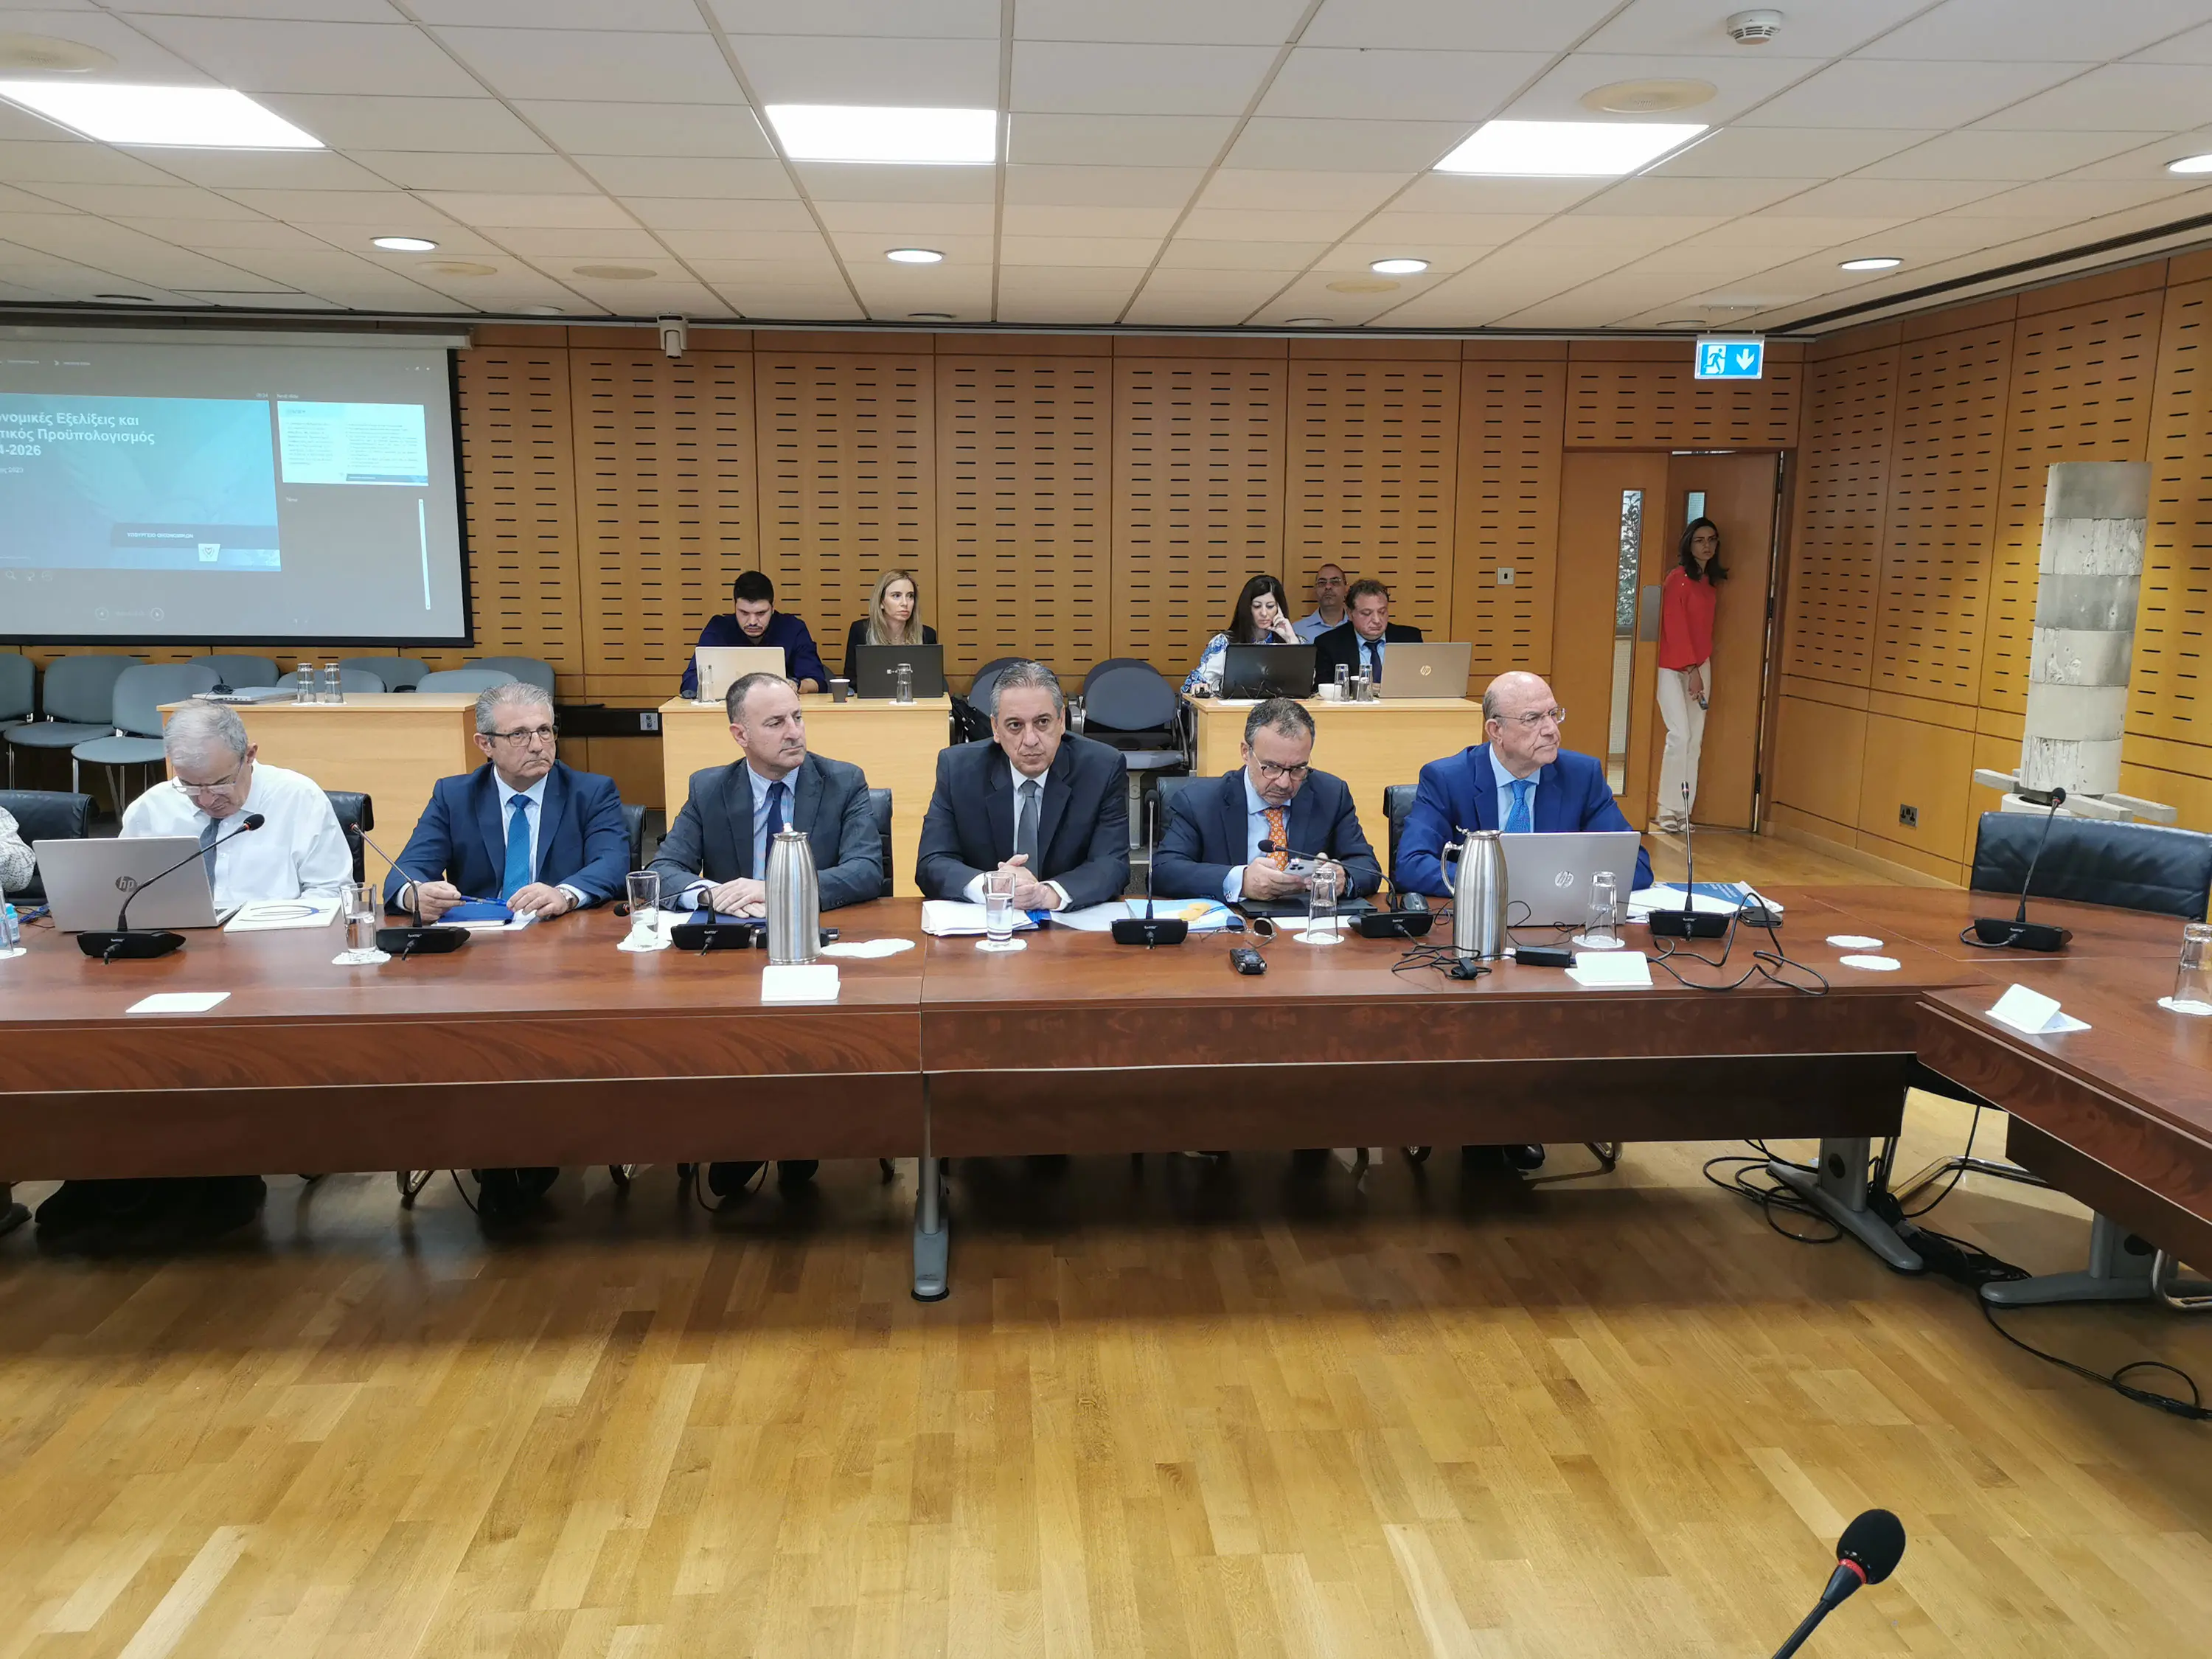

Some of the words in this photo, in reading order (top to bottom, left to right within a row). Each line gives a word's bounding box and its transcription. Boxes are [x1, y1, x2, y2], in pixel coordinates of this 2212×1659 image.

[0, 412, 53, 426] νομικές
[57, 412, 116, 428] Εξελίξεις
[119, 416, 139, 425] και
[38, 428, 155, 445] Προϋπολογισμός
[115, 875, 137, 894] hp
[1554, 870, 1574, 888] hp
